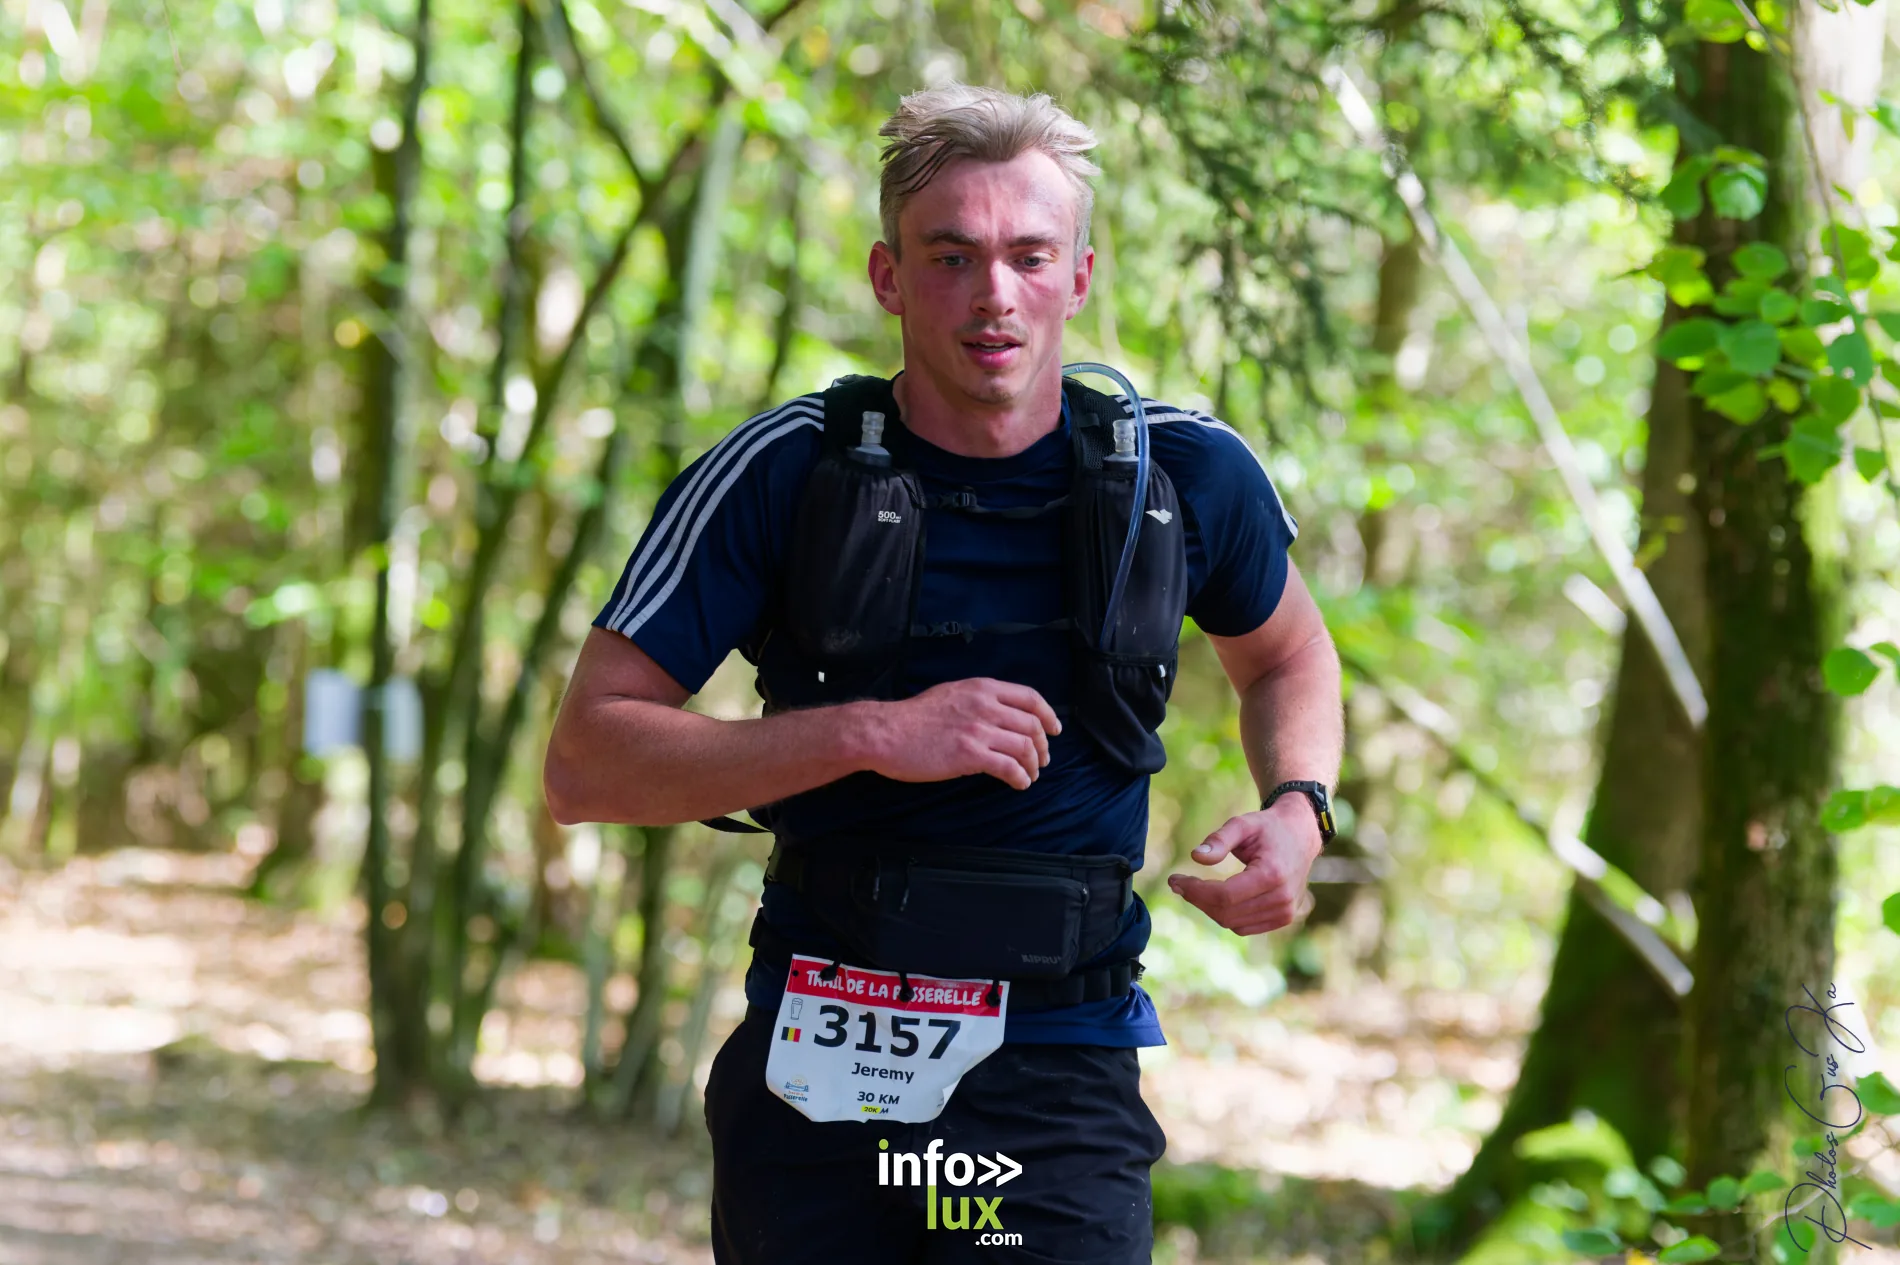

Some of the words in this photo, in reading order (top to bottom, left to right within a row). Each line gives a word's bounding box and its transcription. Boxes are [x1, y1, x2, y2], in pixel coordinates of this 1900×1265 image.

[846, 978, 866, 996] DE
[868, 981, 888, 998] LA
[892, 985, 982, 1006] PSSERELLE
[814, 1004, 961, 1060] 3157
[852, 1062, 914, 1084] Jeremy
[857, 1091, 875, 1102] 30
[878, 1094, 900, 1104] KM
